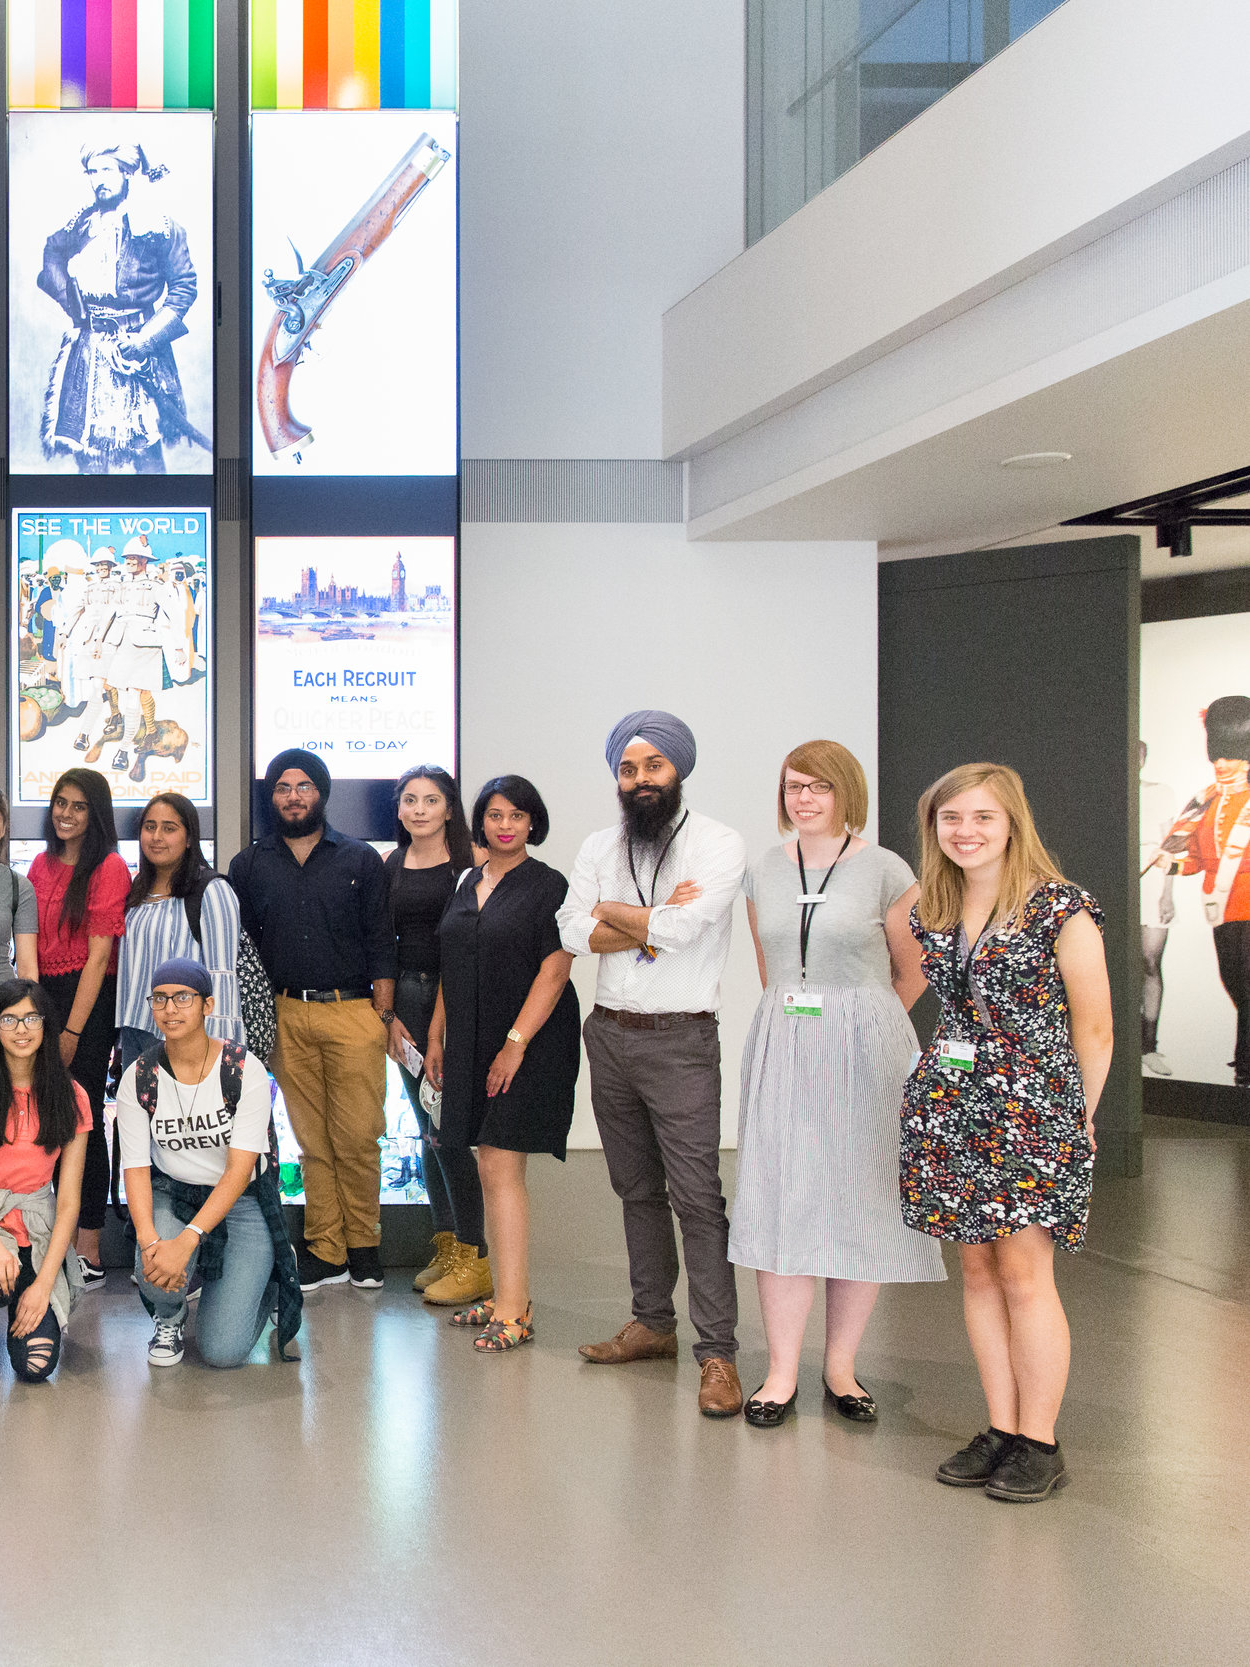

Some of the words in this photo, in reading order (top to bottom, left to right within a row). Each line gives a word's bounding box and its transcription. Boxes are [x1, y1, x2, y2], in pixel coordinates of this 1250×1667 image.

[21, 518, 61, 536] SEE
[69, 518, 111, 535] THE
[119, 517, 199, 535] WORLD
[294, 670, 336, 687] EACH
[344, 669, 417, 687] RECRUIT
[274, 707, 363, 731] QUICKER
[369, 707, 437, 731] PEACE
[302, 741, 334, 750] JOIN
[346, 741, 408, 750] TO-DAY
[151, 771, 202, 783] PAID
[155, 1107, 231, 1135] FEMALE
[157, 1129, 232, 1151] FOREVE
